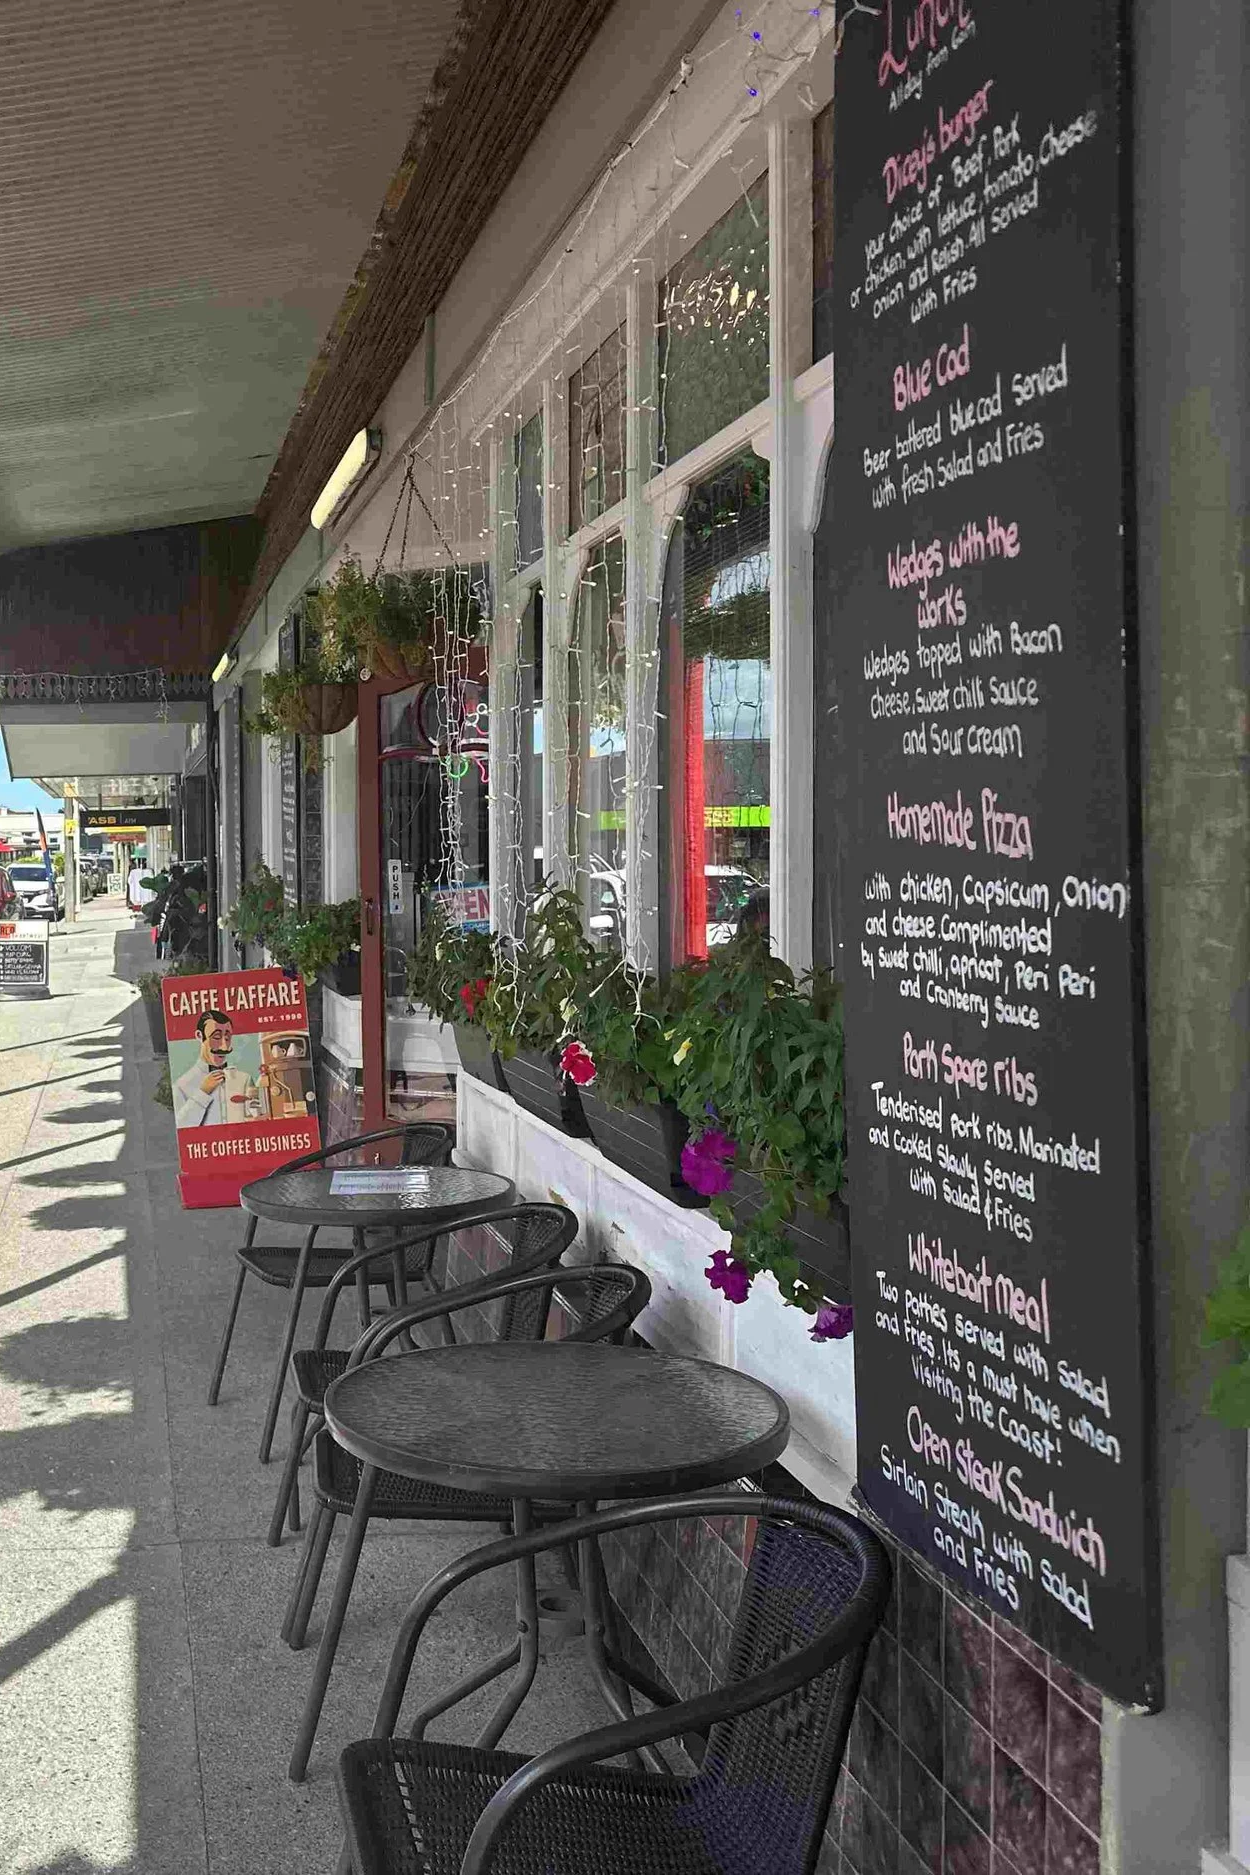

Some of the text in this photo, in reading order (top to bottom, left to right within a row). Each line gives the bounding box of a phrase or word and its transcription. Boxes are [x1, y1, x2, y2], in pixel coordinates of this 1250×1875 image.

[938, 79, 994, 154] burger
[864, 231, 886, 272] your
[889, 201, 923, 244] choice
[927, 173, 944, 210] of
[850, 287, 861, 311] or
[906, 225, 933, 261] with
[873, 281, 905, 320] onion
[908, 253, 930, 290] and
[942, 265, 978, 305] Fries
[893, 321, 971, 412] Blue Cod
[863, 447, 891, 478] Beer
[895, 409, 943, 459] battered
[871, 475, 897, 510] with
[901, 462, 935, 505] fresh
[976, 427, 1003, 468] and
[1004, 420, 1045, 460] Fries
[887, 515, 1022, 600] Wedges with the
[916, 633, 964, 680] topped
[968, 623, 1004, 659] with
[1009, 621, 1064, 656] Bacon
[952, 675, 986, 711] chilli
[902, 721, 928, 756] and
[980, 786, 1035, 862] Pizza
[392, 865, 400, 900] PUSH
[434, 888, 490, 921] EN
[864, 869, 893, 902] with
[1061, 874, 1128, 920] Onion
[864, 908, 888, 938] and
[940, 913, 1053, 957] Complimented
[169, 981, 301, 1017] CAFFE L'AFFARE
[860, 941, 877, 980] by
[1014, 959, 1050, 994] Peri
[1058, 963, 1097, 1000] Peri
[899, 977, 921, 1000] and
[925, 979, 989, 1030] Cranberry
[902, 1030, 1039, 1107] Pork Spare ribs
[187, 1133, 312, 1159] THE COFFEE BUSINESS
[868, 1125, 891, 1149] and
[870, 1080, 943, 1134] Tenderised
[1018, 1124, 1101, 1175] Marinated
[908, 1166, 938, 1201] with
[993, 1198, 1034, 1244] Fries
[907, 1231, 992, 1315] Whitebait
[875, 1270, 899, 1304] Two
[1012, 1341, 1050, 1383] with
[875, 1309, 901, 1337] and
[966, 1360, 977, 1380] a
[981, 1364, 1018, 1404] must
[1023, 1382, 1062, 1431] have
[1067, 1414, 1122, 1465] when
[966, 1384, 996, 1430] the
[879, 1444, 929, 1510] Sirloin
[992, 1530, 1035, 1581] with
[906, 1405, 1108, 1578] Open Steak Sandwich
[932, 1525, 1020, 1612] and Fries
